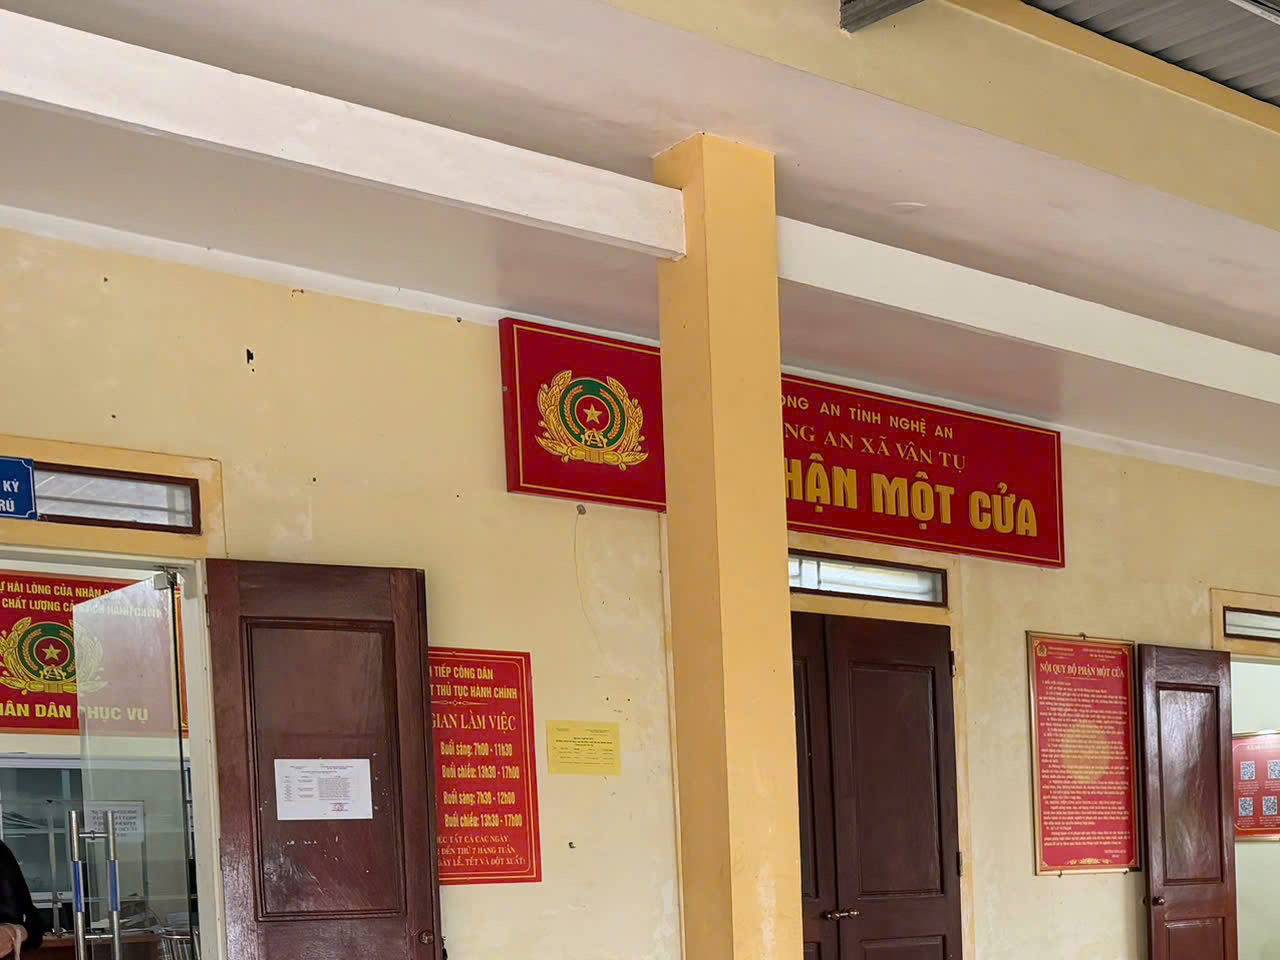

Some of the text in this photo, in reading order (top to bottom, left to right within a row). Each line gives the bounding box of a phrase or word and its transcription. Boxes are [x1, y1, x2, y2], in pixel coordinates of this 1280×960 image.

[781, 395, 953, 439] NG AN TỈNH NGHỆ AN
[784, 422, 967, 473] NG AN XÃ VÂN TỤ
[0, 498, 15, 512] RÚ
[784, 452, 1038, 537] HẬN MỘT CỬA
[7, 581, 24, 593] HÀI
[27, 582, 51, 595] LÒNG
[54, 583, 73, 597] CỦA
[2, 596, 26, 609] CHẤT
[434, 663, 451, 678] TIẾP
[453, 664, 475, 679] CÔNG
[477, 666, 493, 680] DÂN
[436, 681, 451, 696] THỦ
[453, 685, 468, 699] TỤC
[470, 683, 492, 698] HÀNH
[494, 685, 517, 699] CHÍNH
[0, 700, 29, 717] ÂN
[35, 701, 72, 719] DÂN
[127, 707, 149, 724] VỤ
[461, 709, 486, 729] LÀM
[488, 711, 516, 734] VIỆC
